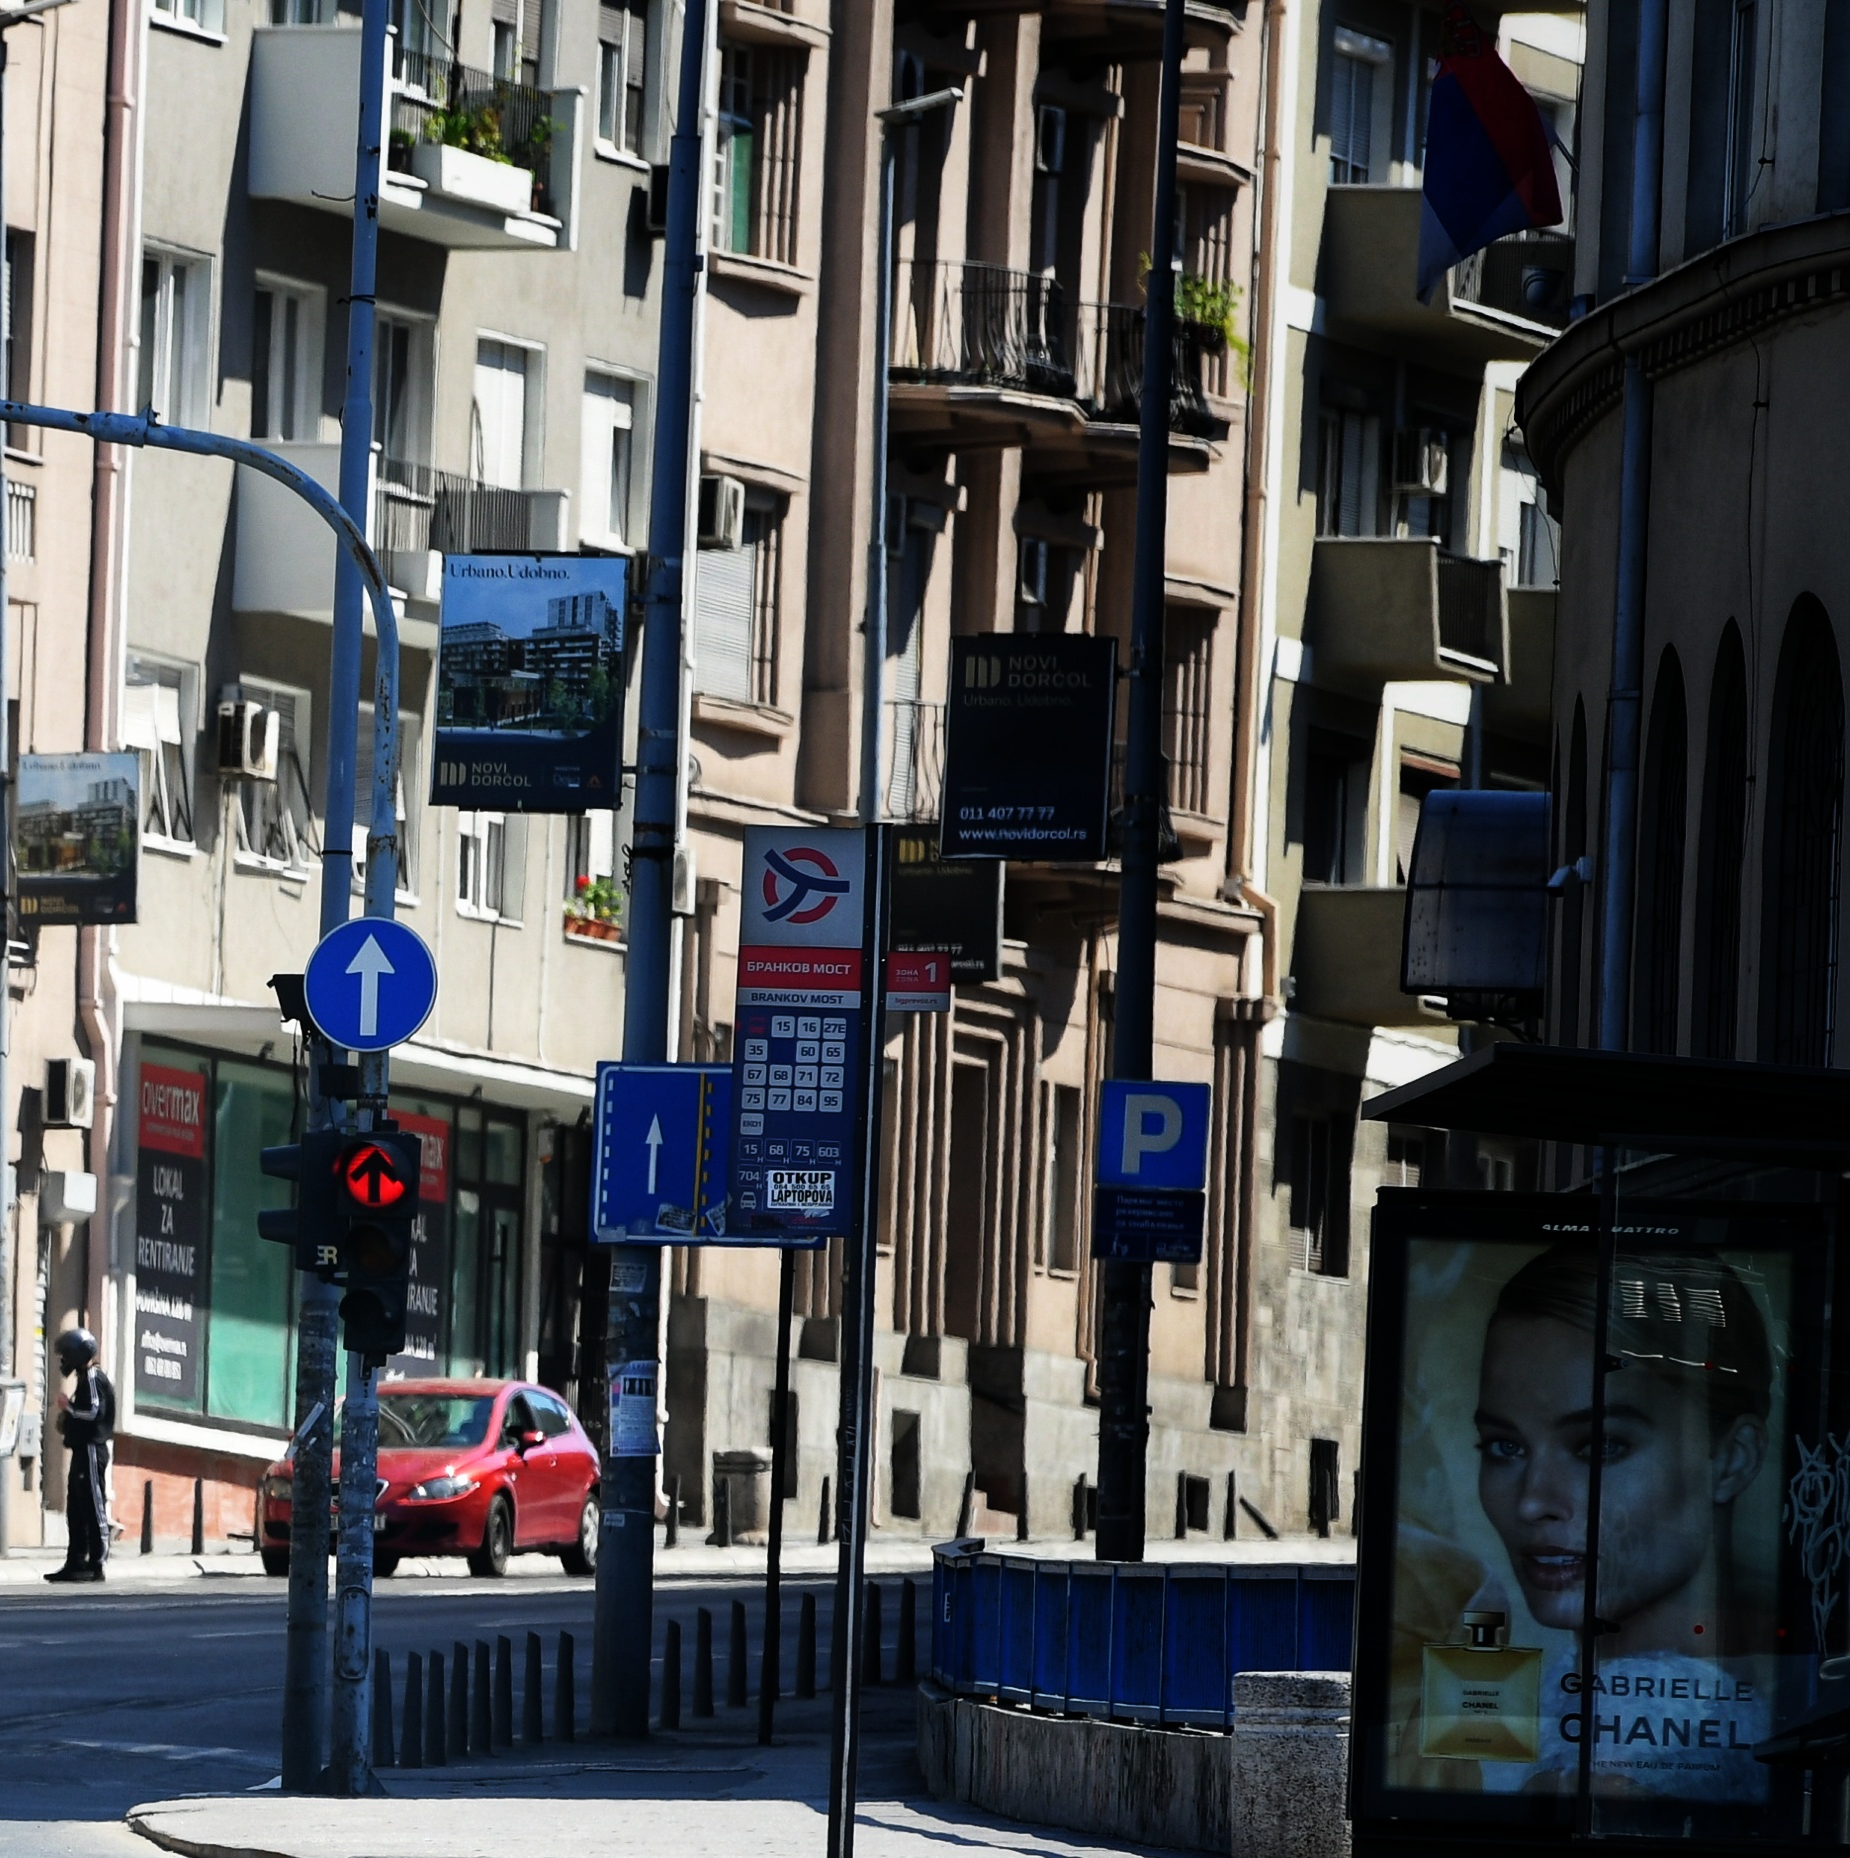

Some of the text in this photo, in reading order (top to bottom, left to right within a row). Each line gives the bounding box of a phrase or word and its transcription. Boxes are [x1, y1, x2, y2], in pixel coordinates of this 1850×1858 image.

[471, 762, 508, 774] NOVI
[960, 807, 984, 820] 011
[987, 807, 1013, 820] 407
[958, 828, 1087, 841] www.novidorcol.rs
[747, 961, 851, 975] БРАНКОВ МОСТ
[925, 962, 937, 982] 1
[751, 992, 844, 1004] BRANKOV MOST
[776, 1021, 846, 1033] 15 16 27E
[748, 1045, 841, 1057] 35 60 65
[747, 1070, 839, 1082] 67 68 71 72
[143, 1081, 199, 1126] overmax
[746, 1093, 838, 1106] 75 77 84 95
[1121, 1094, 1182, 1174] P
[744, 1144, 758, 1155] 15
[769, 1145, 784, 1156] 68
[795, 1145, 810, 1156] 75
[818, 1147, 839, 1158] 603
[739, 1170, 760, 1181] 704
[773, 1172, 832, 1184] OTKUP
[153, 1165, 184, 1200] LOKAL
[771, 1190, 832, 1202] LAPTOPOVA
[161, 1203, 174, 1235] ZA
[1542, 1223, 1679, 1235] ALMA UATTRO
[1560, 1672, 1754, 1701] GABRIELLE
[1461, 1701, 1500, 1710] CHANEL
[1559, 1712, 1753, 1751] CHANEL
[1636, 1761, 1657, 1770] EAU
